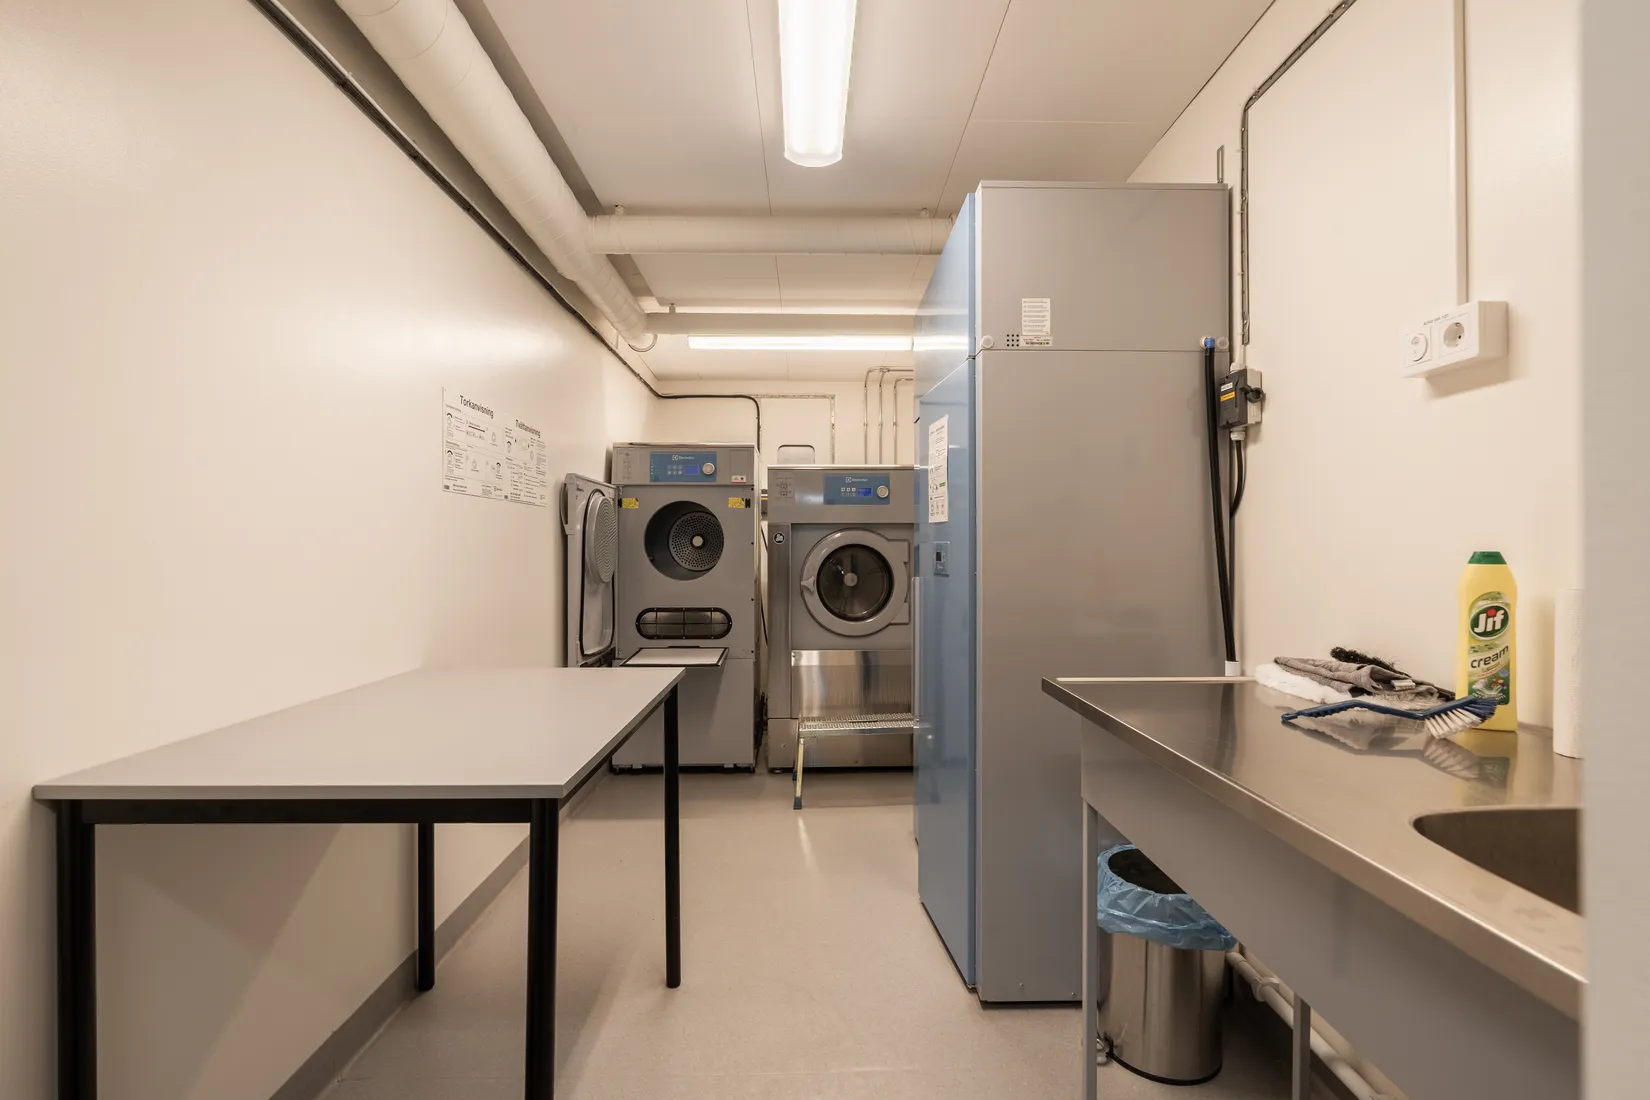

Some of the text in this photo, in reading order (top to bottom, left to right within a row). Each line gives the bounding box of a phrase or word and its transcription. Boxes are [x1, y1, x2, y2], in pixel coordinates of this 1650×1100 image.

[460, 395, 494, 419] Torkanvisning
[1474, 608, 1505, 633] Jif
[1470, 646, 1509, 669] cream
